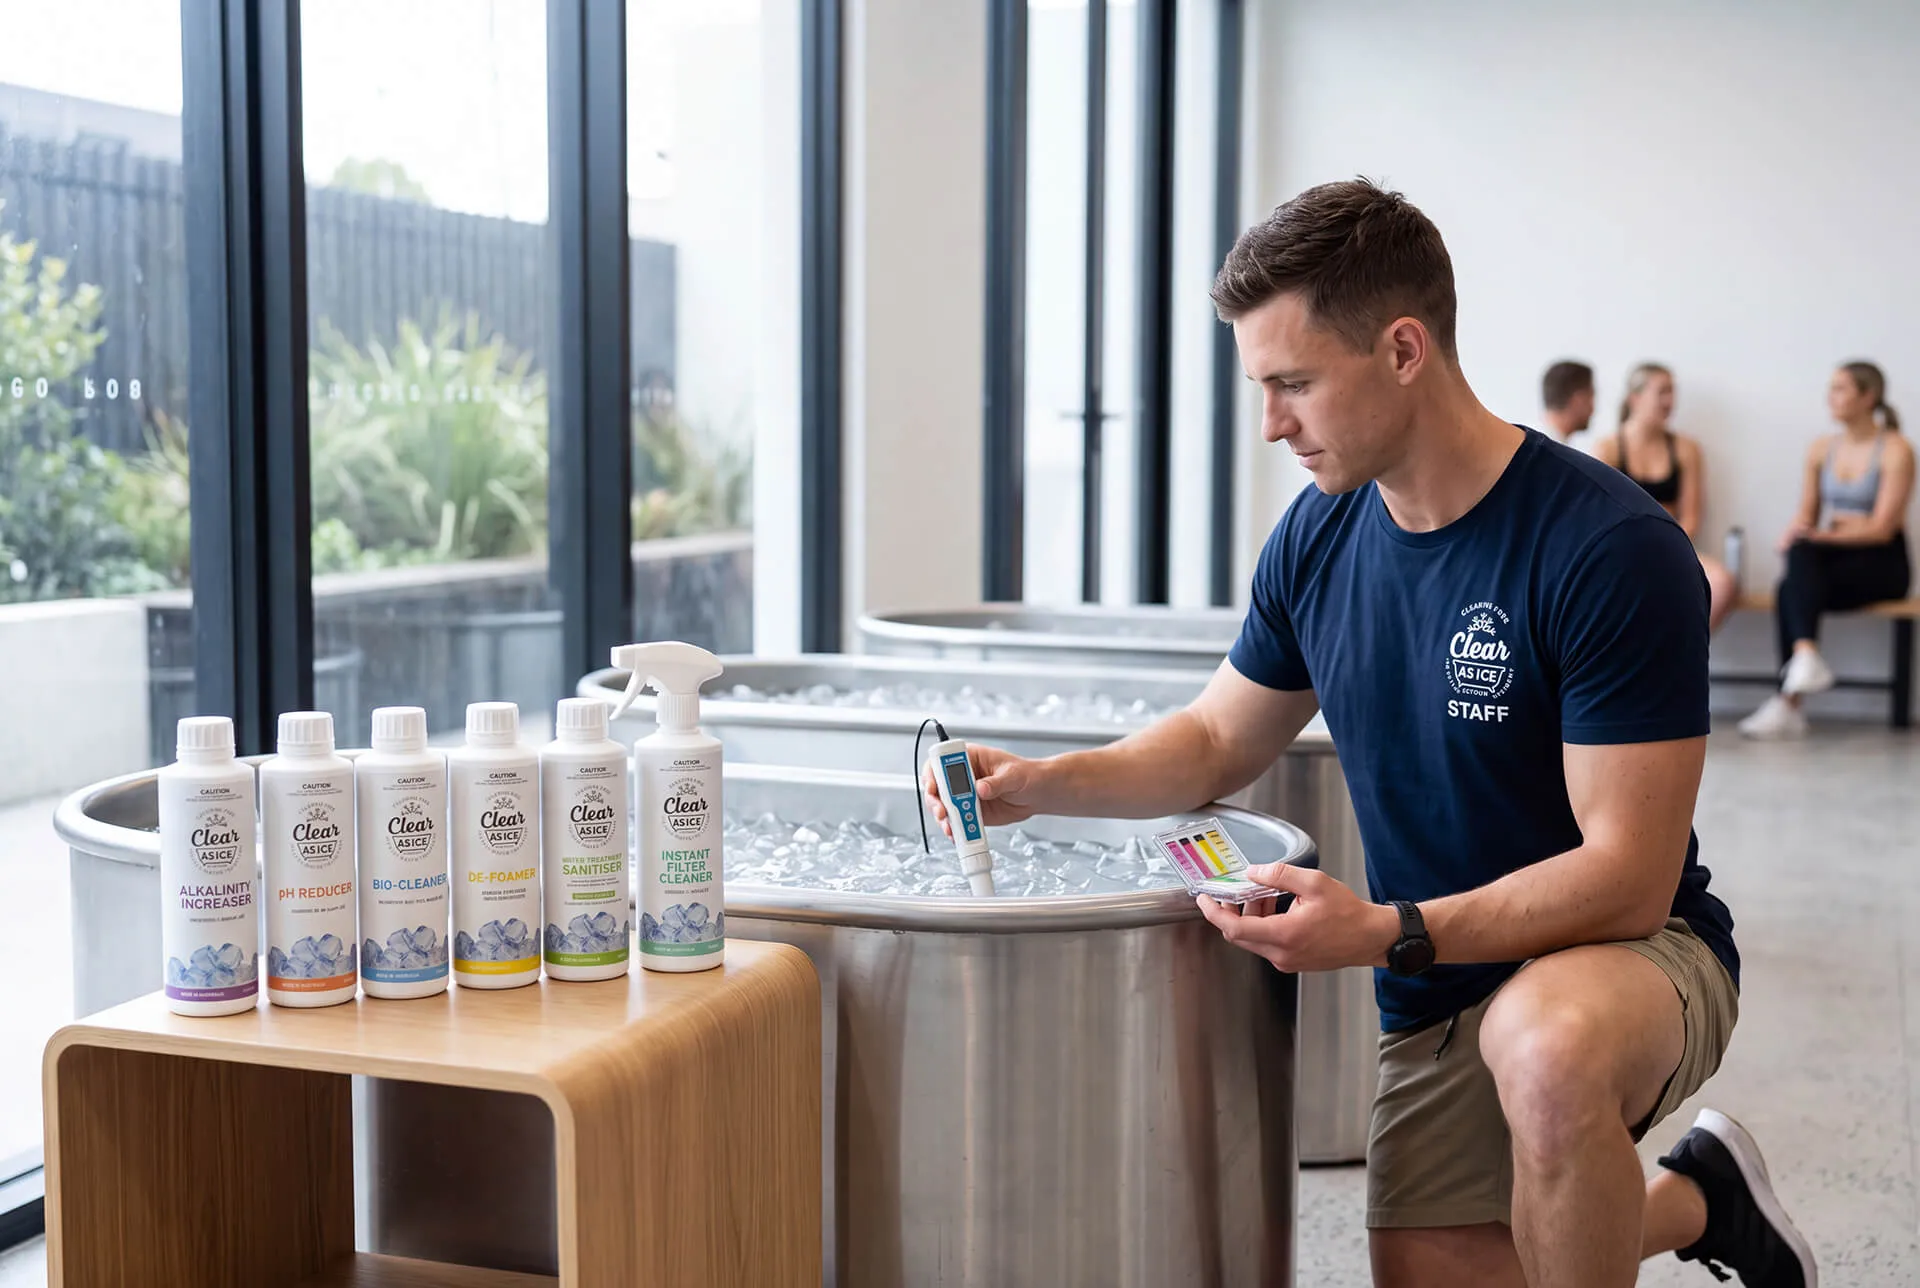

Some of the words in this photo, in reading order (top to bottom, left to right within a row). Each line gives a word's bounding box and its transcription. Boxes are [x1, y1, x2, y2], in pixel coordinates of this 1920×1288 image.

[1449, 631, 1511, 661] Clear
[1458, 666, 1474, 679] AS
[1476, 668, 1497, 683] ICE
[1447, 700, 1509, 722] STAFF
[570, 805, 614, 823] Clear
[663, 797, 708, 814] Clear
[388, 817, 434, 835] Clear
[480, 811, 526, 829] Clear
[191, 829, 240, 847] Clear
[293, 823, 340, 841] Clear
[661, 849, 711, 861] INSTANT
[468, 867, 536, 883] DE-FOAMER
[562, 861, 622, 875] SANITISER
[667, 861, 706, 872] FILTER
[372, 873, 448, 890] BIO-CLEANER
[659, 871, 713, 884] CLEANER
[180, 880, 251, 897] ALKALINITY
[279, 888, 295, 901] pH
[298, 881, 352, 899] REDUCER
[181, 894, 252, 909] INCREASER
